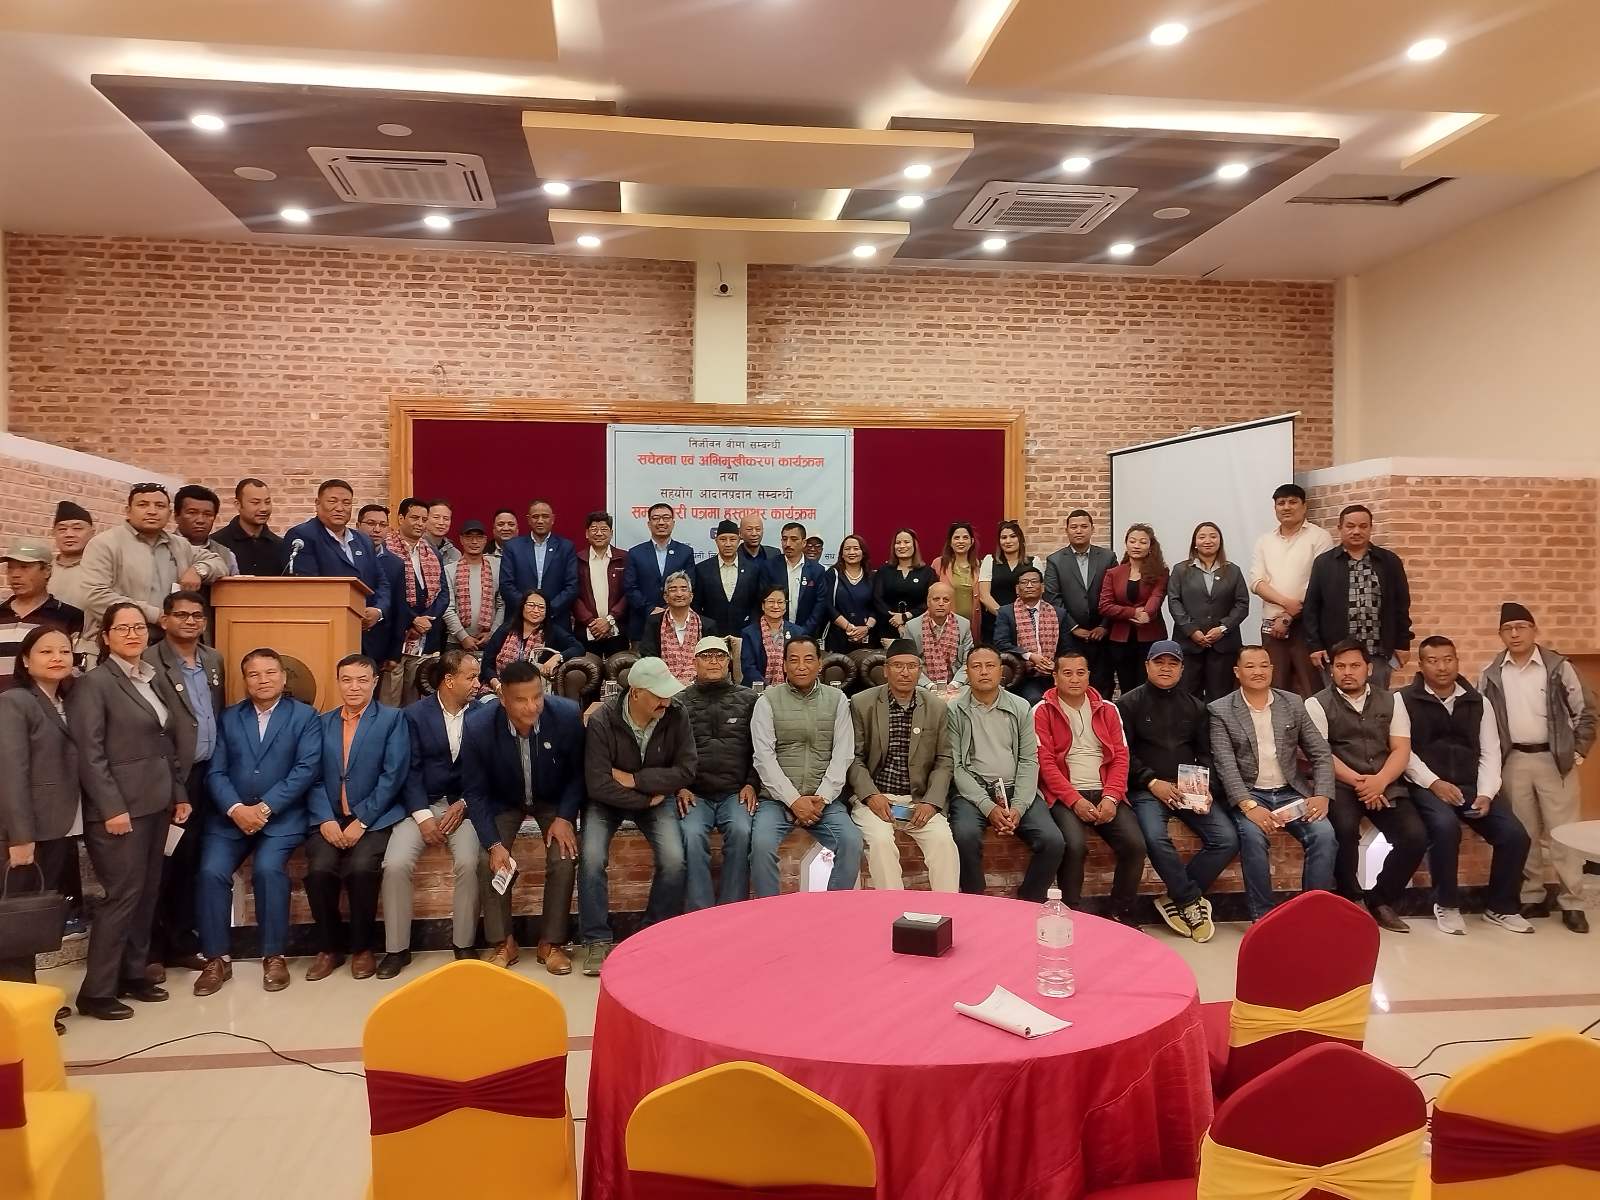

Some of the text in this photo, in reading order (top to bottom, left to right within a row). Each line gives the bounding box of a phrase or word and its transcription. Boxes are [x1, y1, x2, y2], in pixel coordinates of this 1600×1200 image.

[726, 438, 745, 449] बीमा
[750, 439, 780, 449] सम्बन्धी
[637, 451, 676, 466] सचेतना
[699, 452, 774, 469] अभिमुखीकरण
[778, 455, 824, 468] कार्यक्रम
[720, 472, 738, 482] तथा
[660, 487, 794, 500] सहयोग आदानप्रदान सम्बन्धी
[691, 507, 720, 520] पत्रमा
[770, 506, 817, 520] कार्यक्रम
